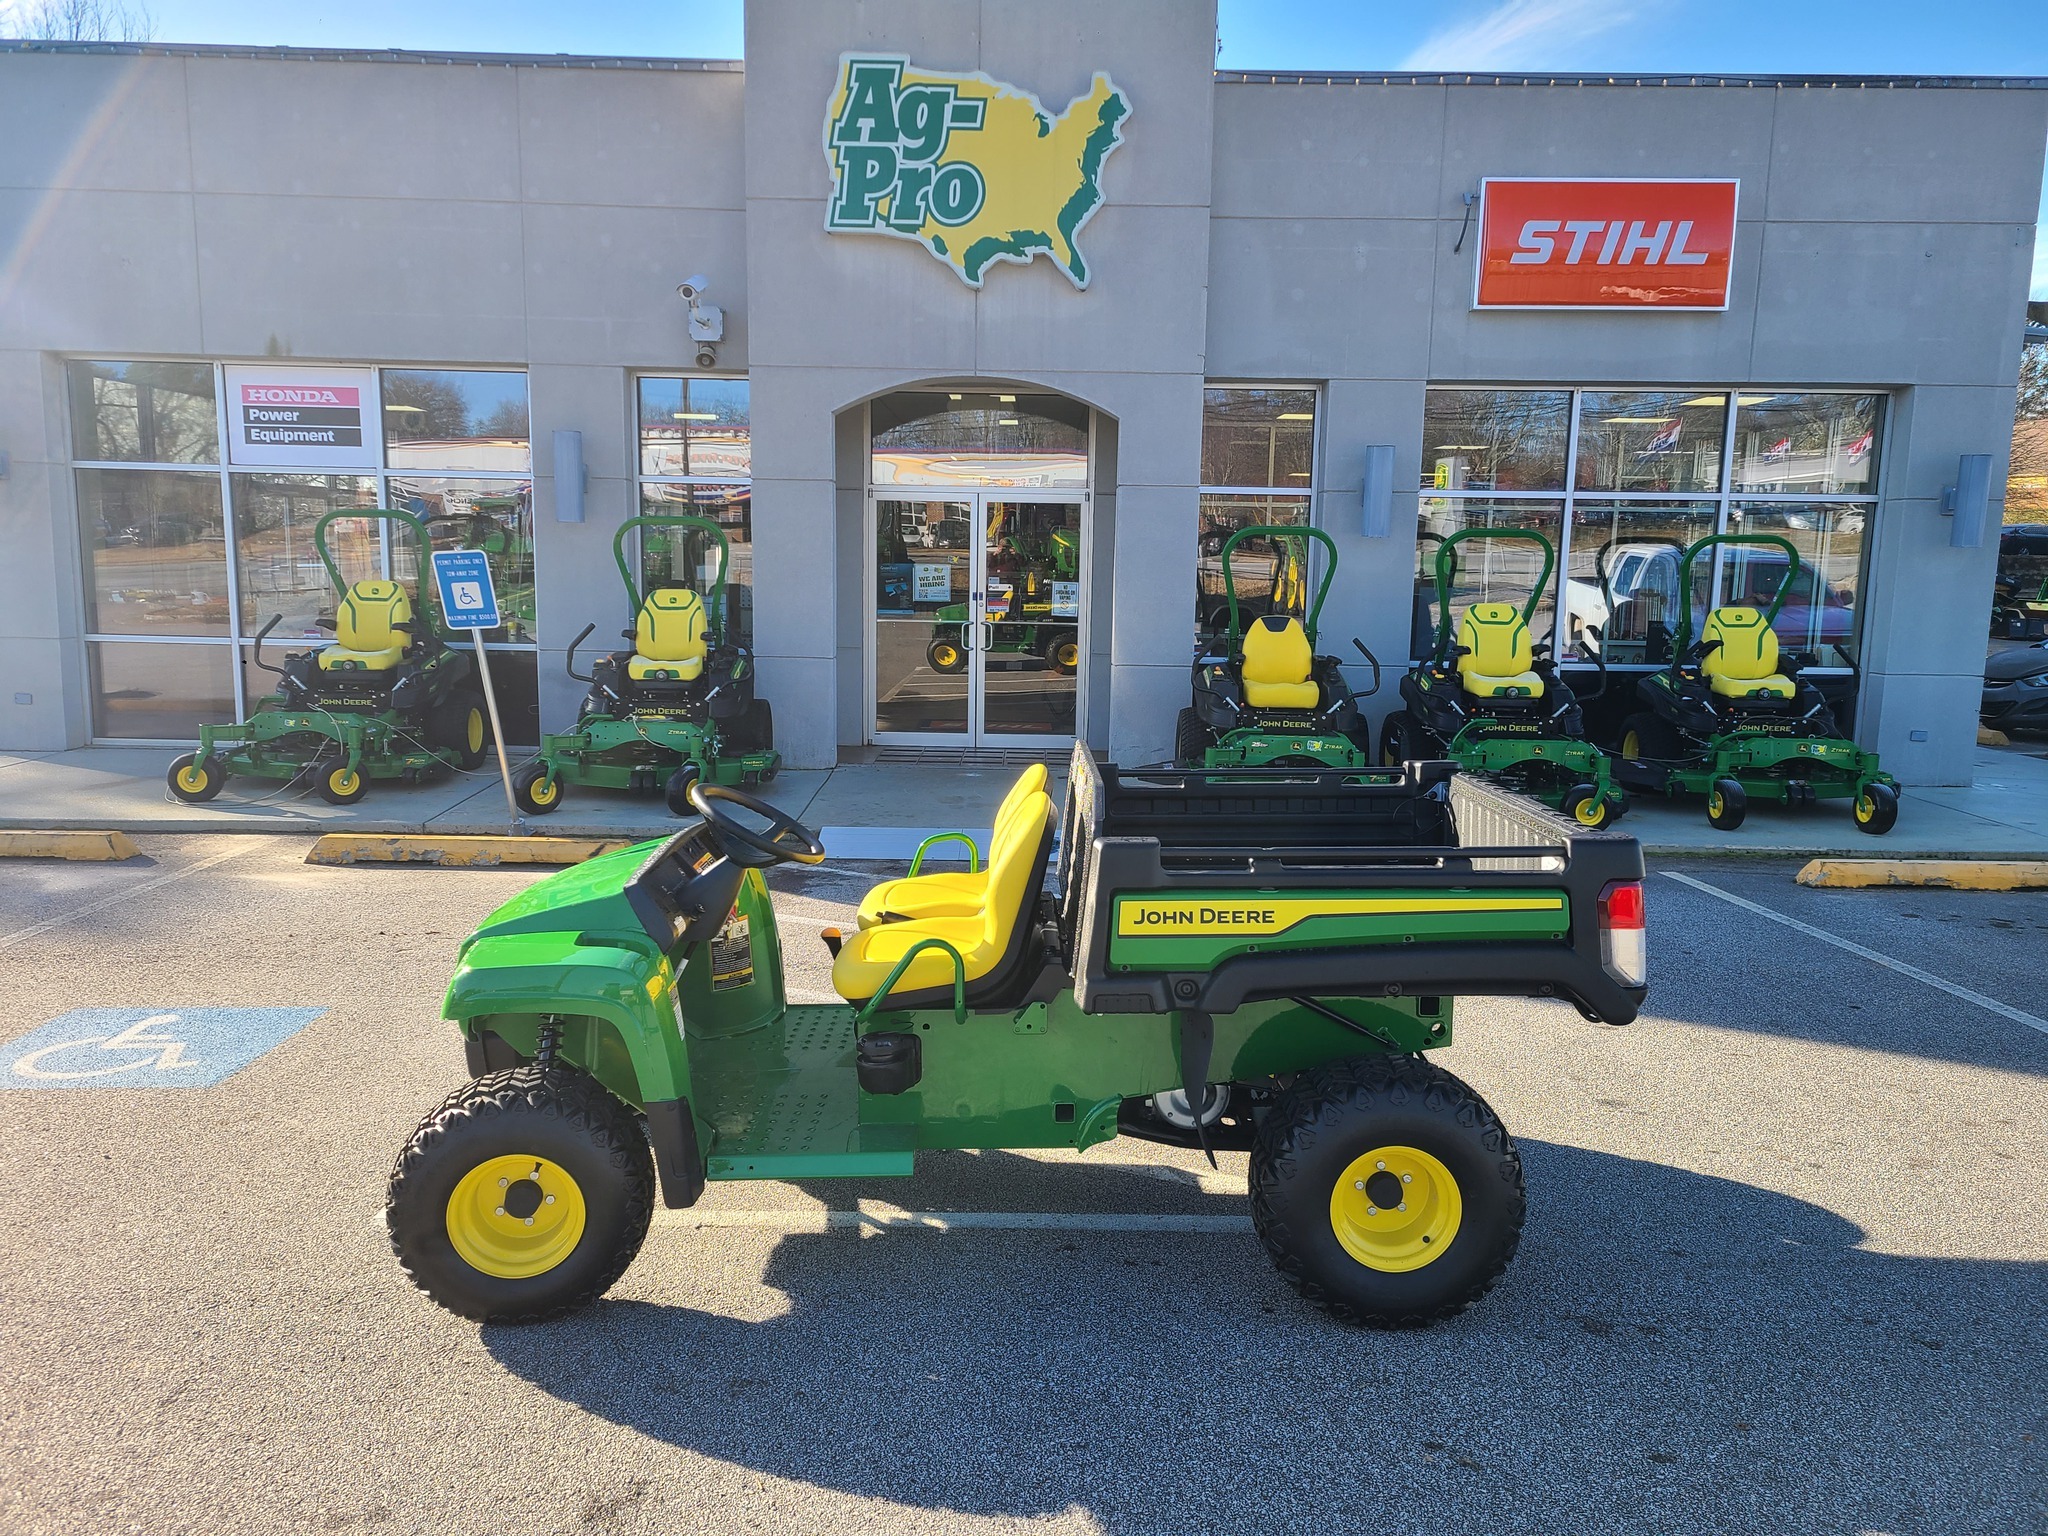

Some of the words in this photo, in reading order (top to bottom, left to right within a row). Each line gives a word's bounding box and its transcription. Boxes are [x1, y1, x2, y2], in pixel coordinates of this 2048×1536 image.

[830, 60, 987, 163] Ag-
[830, 145, 986, 227] Pro
[1509, 220, 1709, 265] STIHL
[247, 388, 339, 403] HONDA
[248, 408, 300, 421] Power
[250, 428, 335, 443] Equipment
[632, 707, 656, 715] JOHN
[658, 707, 687, 715] DEERE
[1257, 720, 1281, 728] JOHN
[1282, 720, 1312, 728] DEERE
[1762, 724, 1791, 732] DEERE
[1133, 908, 1194, 925] JOHN
[1200, 908, 1275, 924] DEERE
